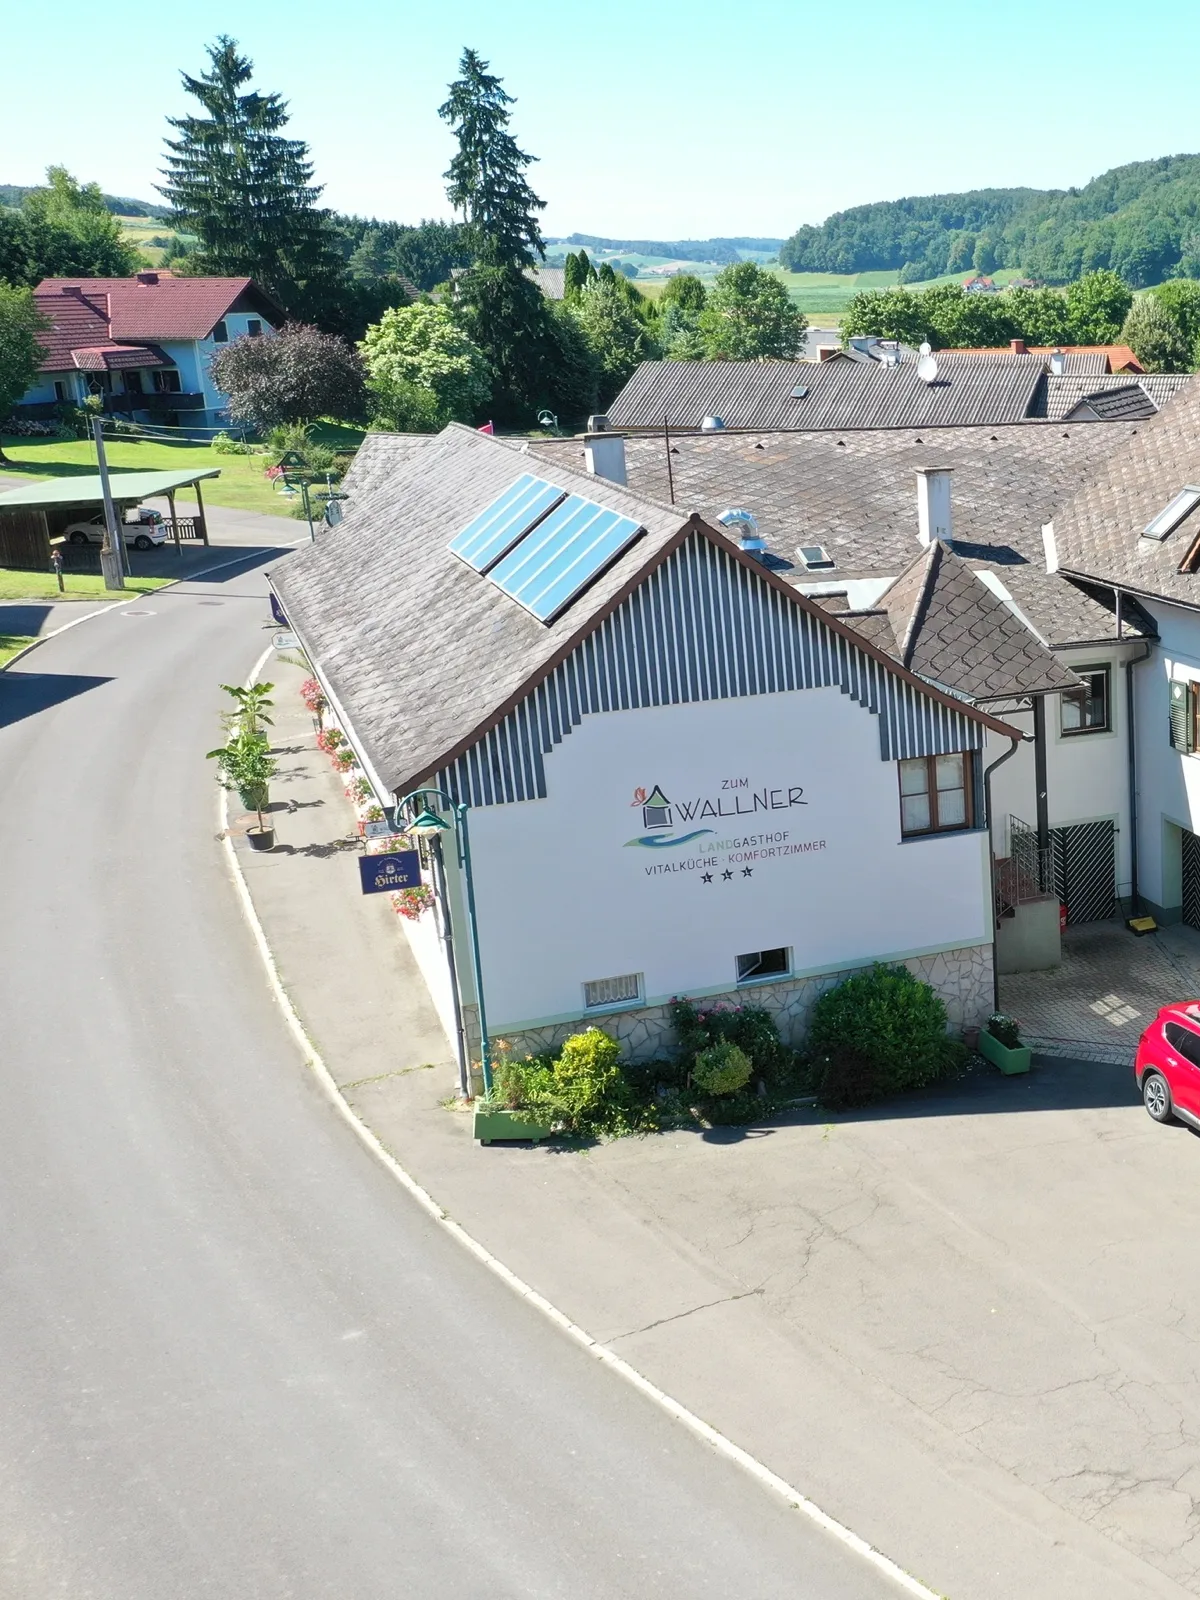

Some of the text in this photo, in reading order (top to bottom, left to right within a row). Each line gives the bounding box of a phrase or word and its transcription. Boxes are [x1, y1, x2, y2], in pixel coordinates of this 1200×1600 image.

[721, 777, 749, 790] ZUM
[675, 787, 808, 822] WALLNER
[699, 831, 790, 854] LANDGASTHOF
[645, 840, 827, 876] VITALKÜCHE KOMFORTZIMMER
[375, 875, 408, 887] Hirter
